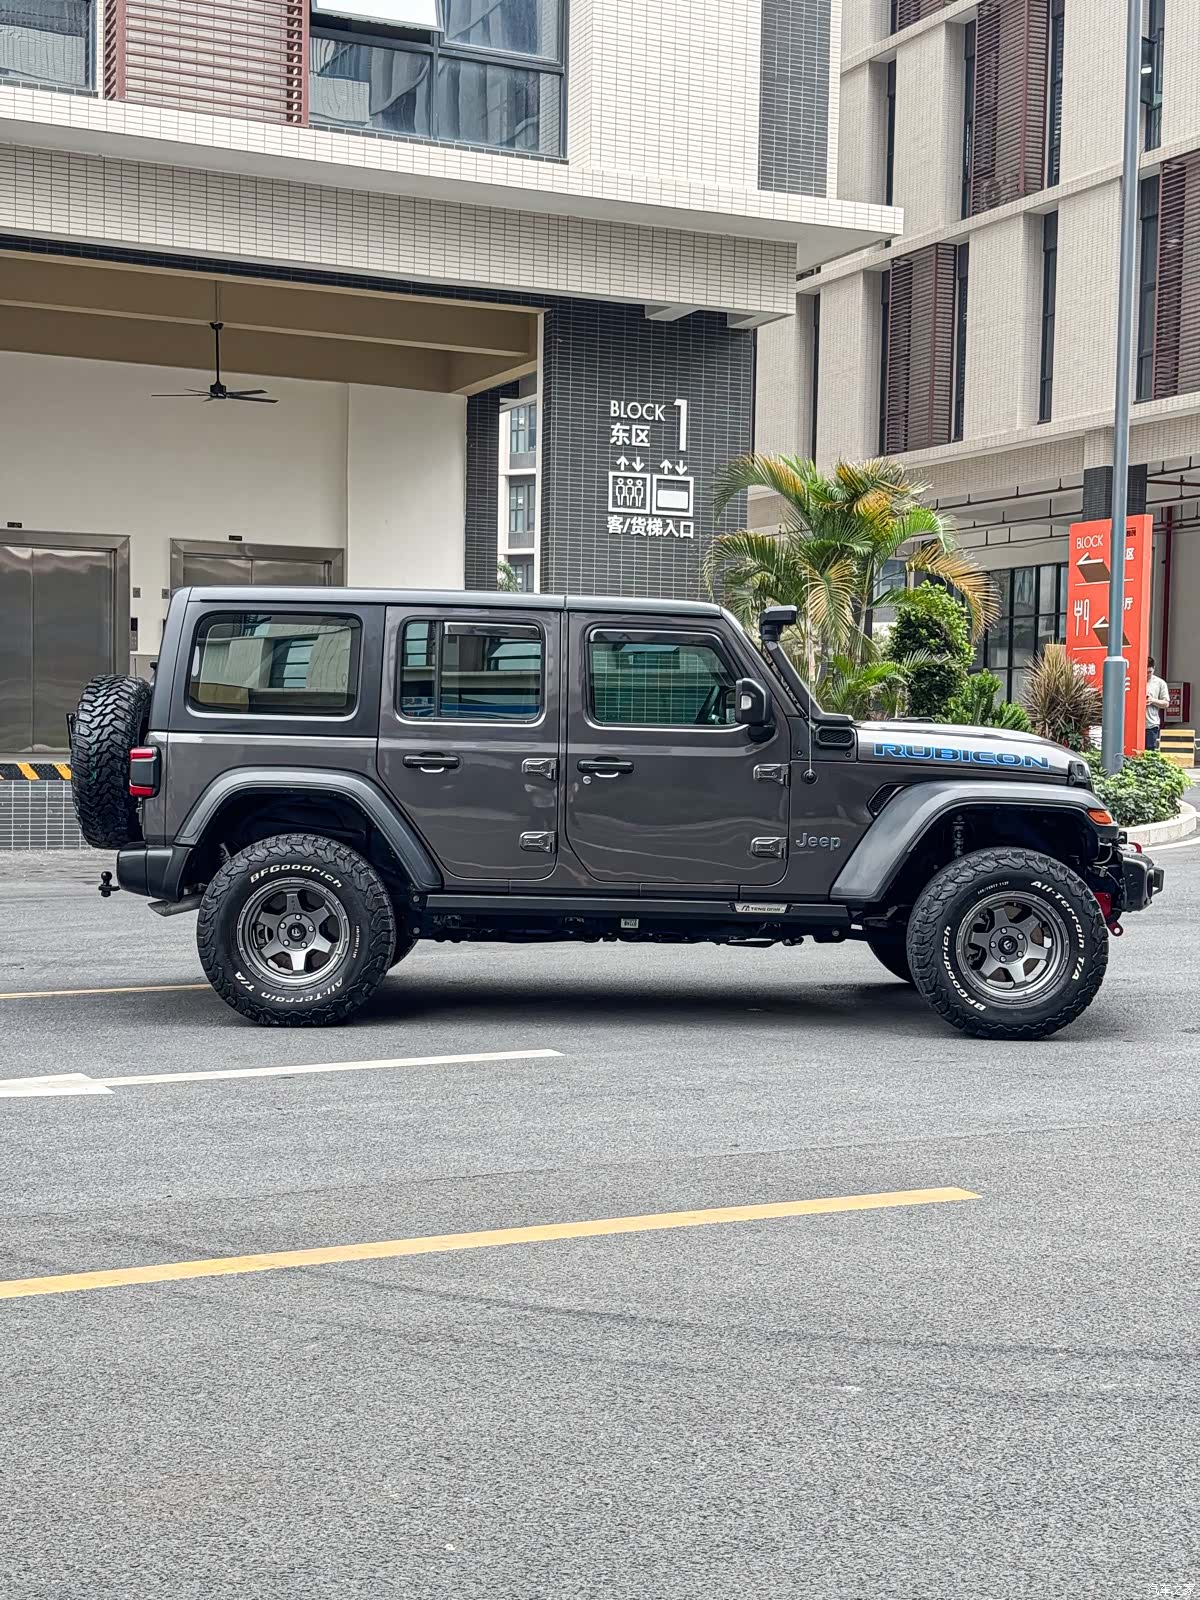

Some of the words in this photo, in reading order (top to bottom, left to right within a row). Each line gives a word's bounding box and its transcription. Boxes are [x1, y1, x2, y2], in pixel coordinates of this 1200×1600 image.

[609, 422, 651, 447] 东区
[610, 400, 667, 421] BLOCK
[673, 398, 688, 451] 1
[607, 515, 694, 539] 客/货梯入口
[1076, 534, 1104, 550] BLOCK
[873, 743, 1050, 769] RUBICON
[795, 832, 841, 851] Jeep
[250, 863, 343, 889] BFGoodrich
[1030, 880, 1086, 950] All-Terrain
[1071, 956, 1086, 981] T/A
[234, 971, 256, 992] T/A
[941, 925, 987, 1012] BFGoodrich
[260, 976, 344, 1004] All-Terrain
